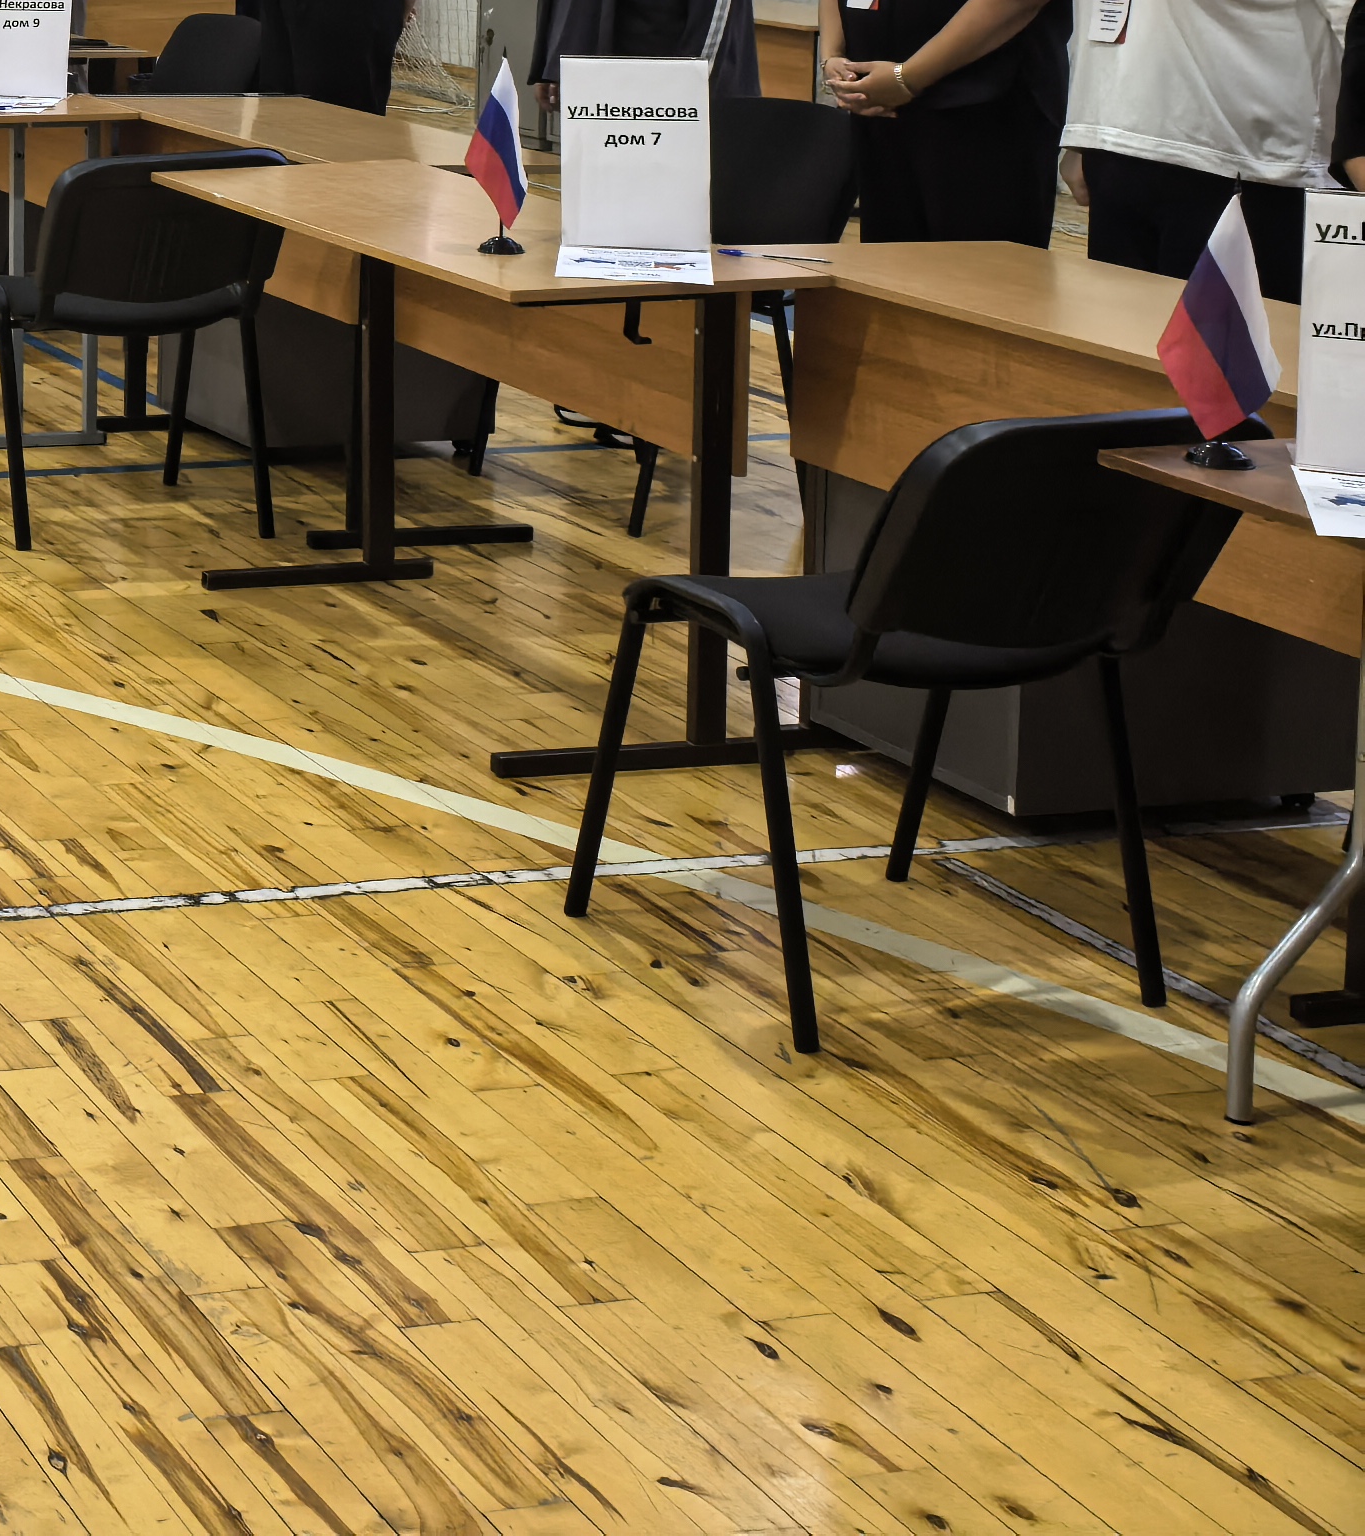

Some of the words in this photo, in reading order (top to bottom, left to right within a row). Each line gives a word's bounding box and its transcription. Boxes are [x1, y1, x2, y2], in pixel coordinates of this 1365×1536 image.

[2, 19, 30, 30] дом
[32, 18, 41, 28] 9
[567, 103, 699, 120] ул.Некрасова
[604, 133, 646, 148] дом
[651, 132, 663, 146] 7
[1315, 221, 1365, 242] ул.
